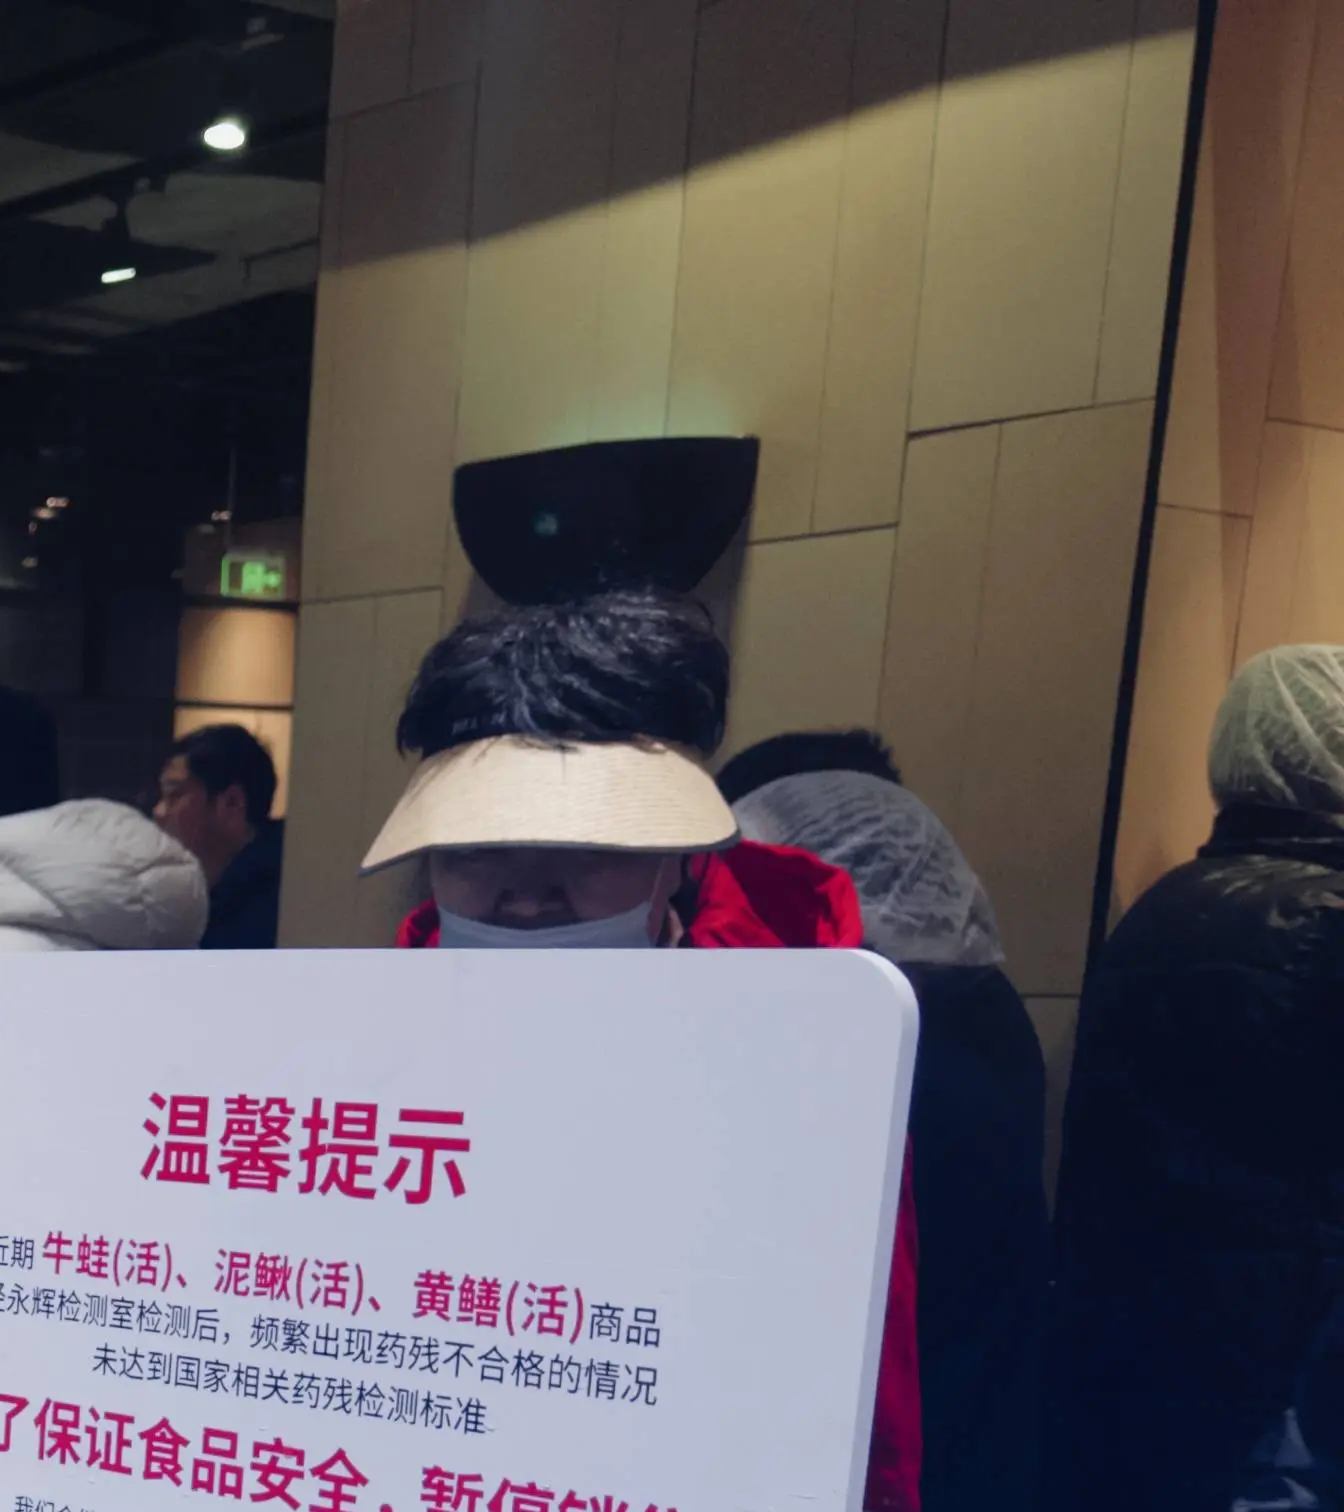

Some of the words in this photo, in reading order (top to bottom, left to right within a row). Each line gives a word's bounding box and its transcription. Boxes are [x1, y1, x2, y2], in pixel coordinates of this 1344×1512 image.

[140, 1091, 472, 1205] 温馨提示
[92, 1342, 488, 1435] 未达到国家相关药残检测标准
